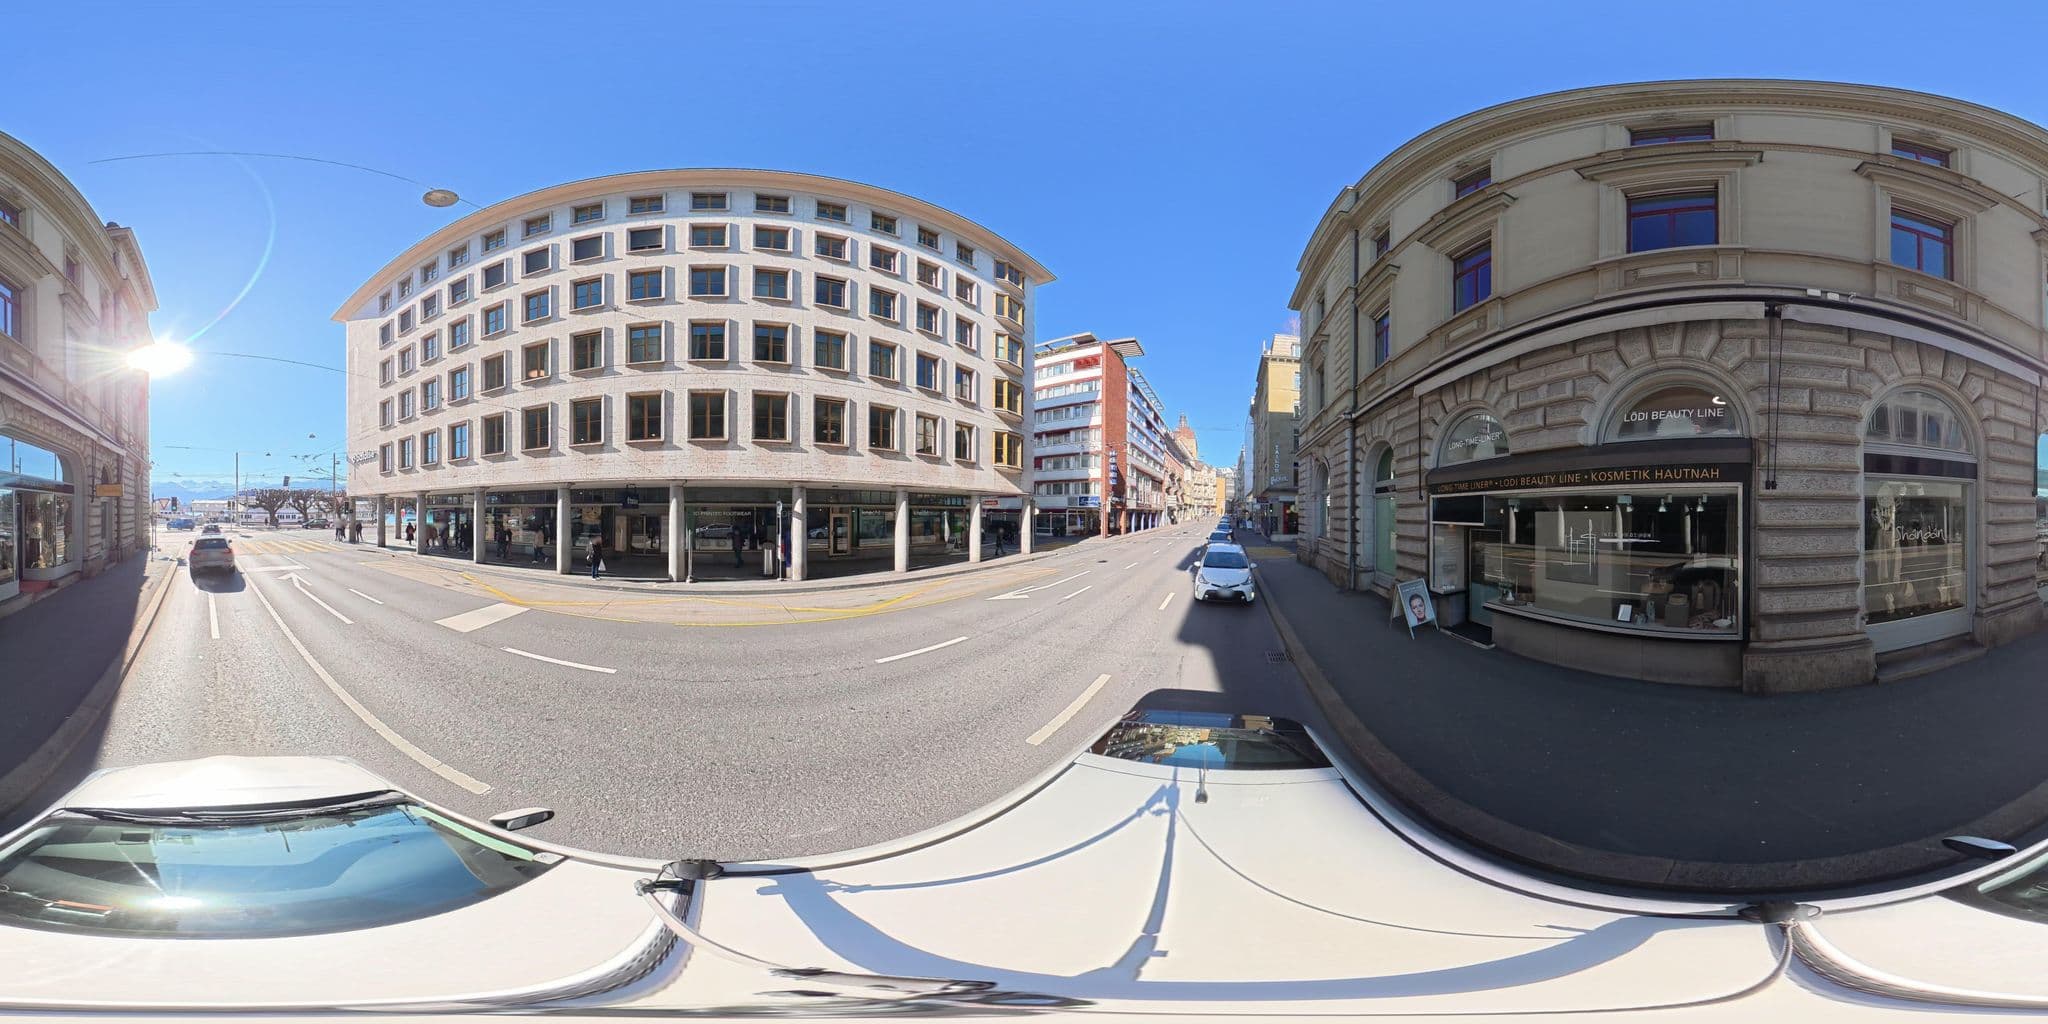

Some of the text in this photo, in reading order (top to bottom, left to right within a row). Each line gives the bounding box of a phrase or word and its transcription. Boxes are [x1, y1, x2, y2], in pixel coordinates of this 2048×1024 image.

[1651, 408, 1693, 420] BEAUTY
[1697, 407, 1724, 418] LINE
[1520, 475, 1556, 486] BEAUTY
[1560, 473, 1581, 484] LINE
[1591, 469, 1650, 482] KOSMETIK
[1655, 467, 1720, 480] HAUTNAH
